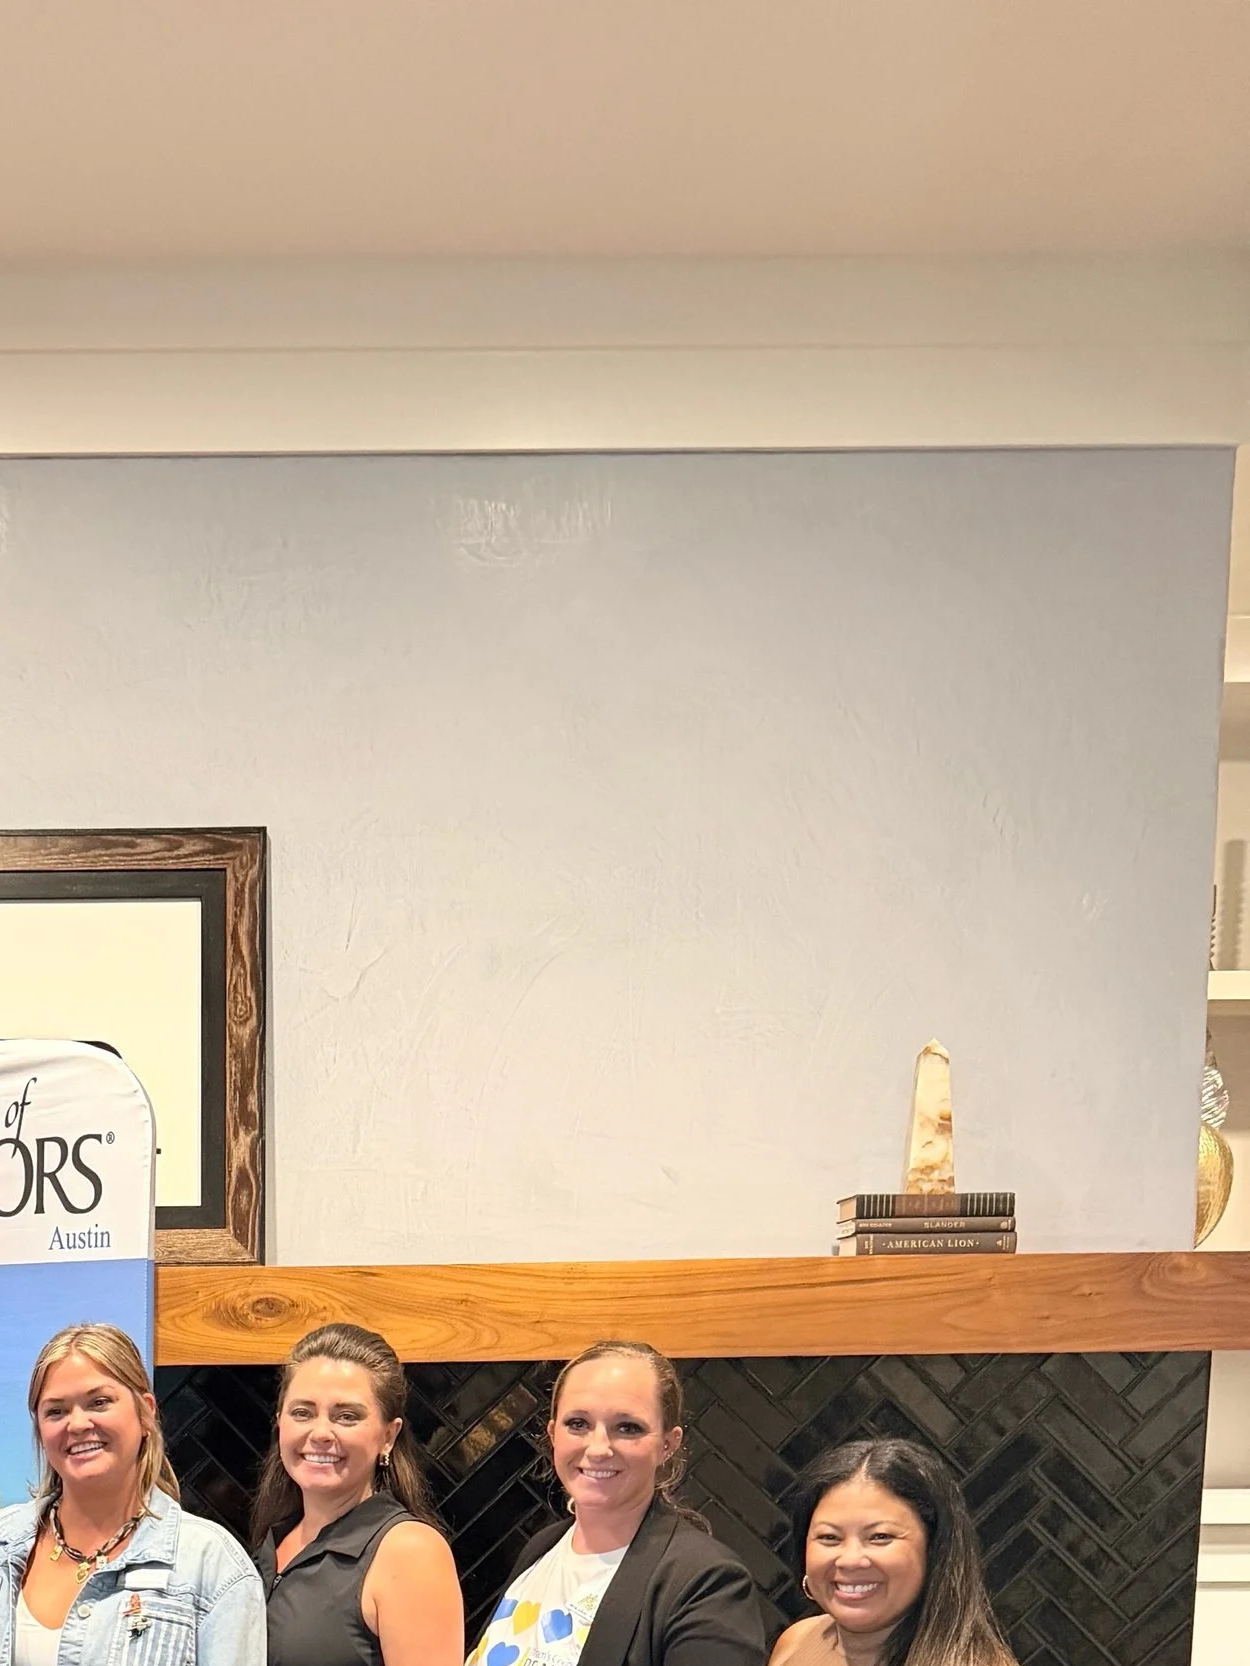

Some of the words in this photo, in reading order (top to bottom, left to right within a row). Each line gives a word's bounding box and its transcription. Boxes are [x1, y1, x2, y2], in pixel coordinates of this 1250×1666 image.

[4, 1077, 37, 1159] of
[923, 1221, 966, 1229] SLANDER
[48, 1223, 112, 1250] Austin
[887, 1239, 944, 1248] AMERICAN
[947, 1239, 975, 1248] LION
